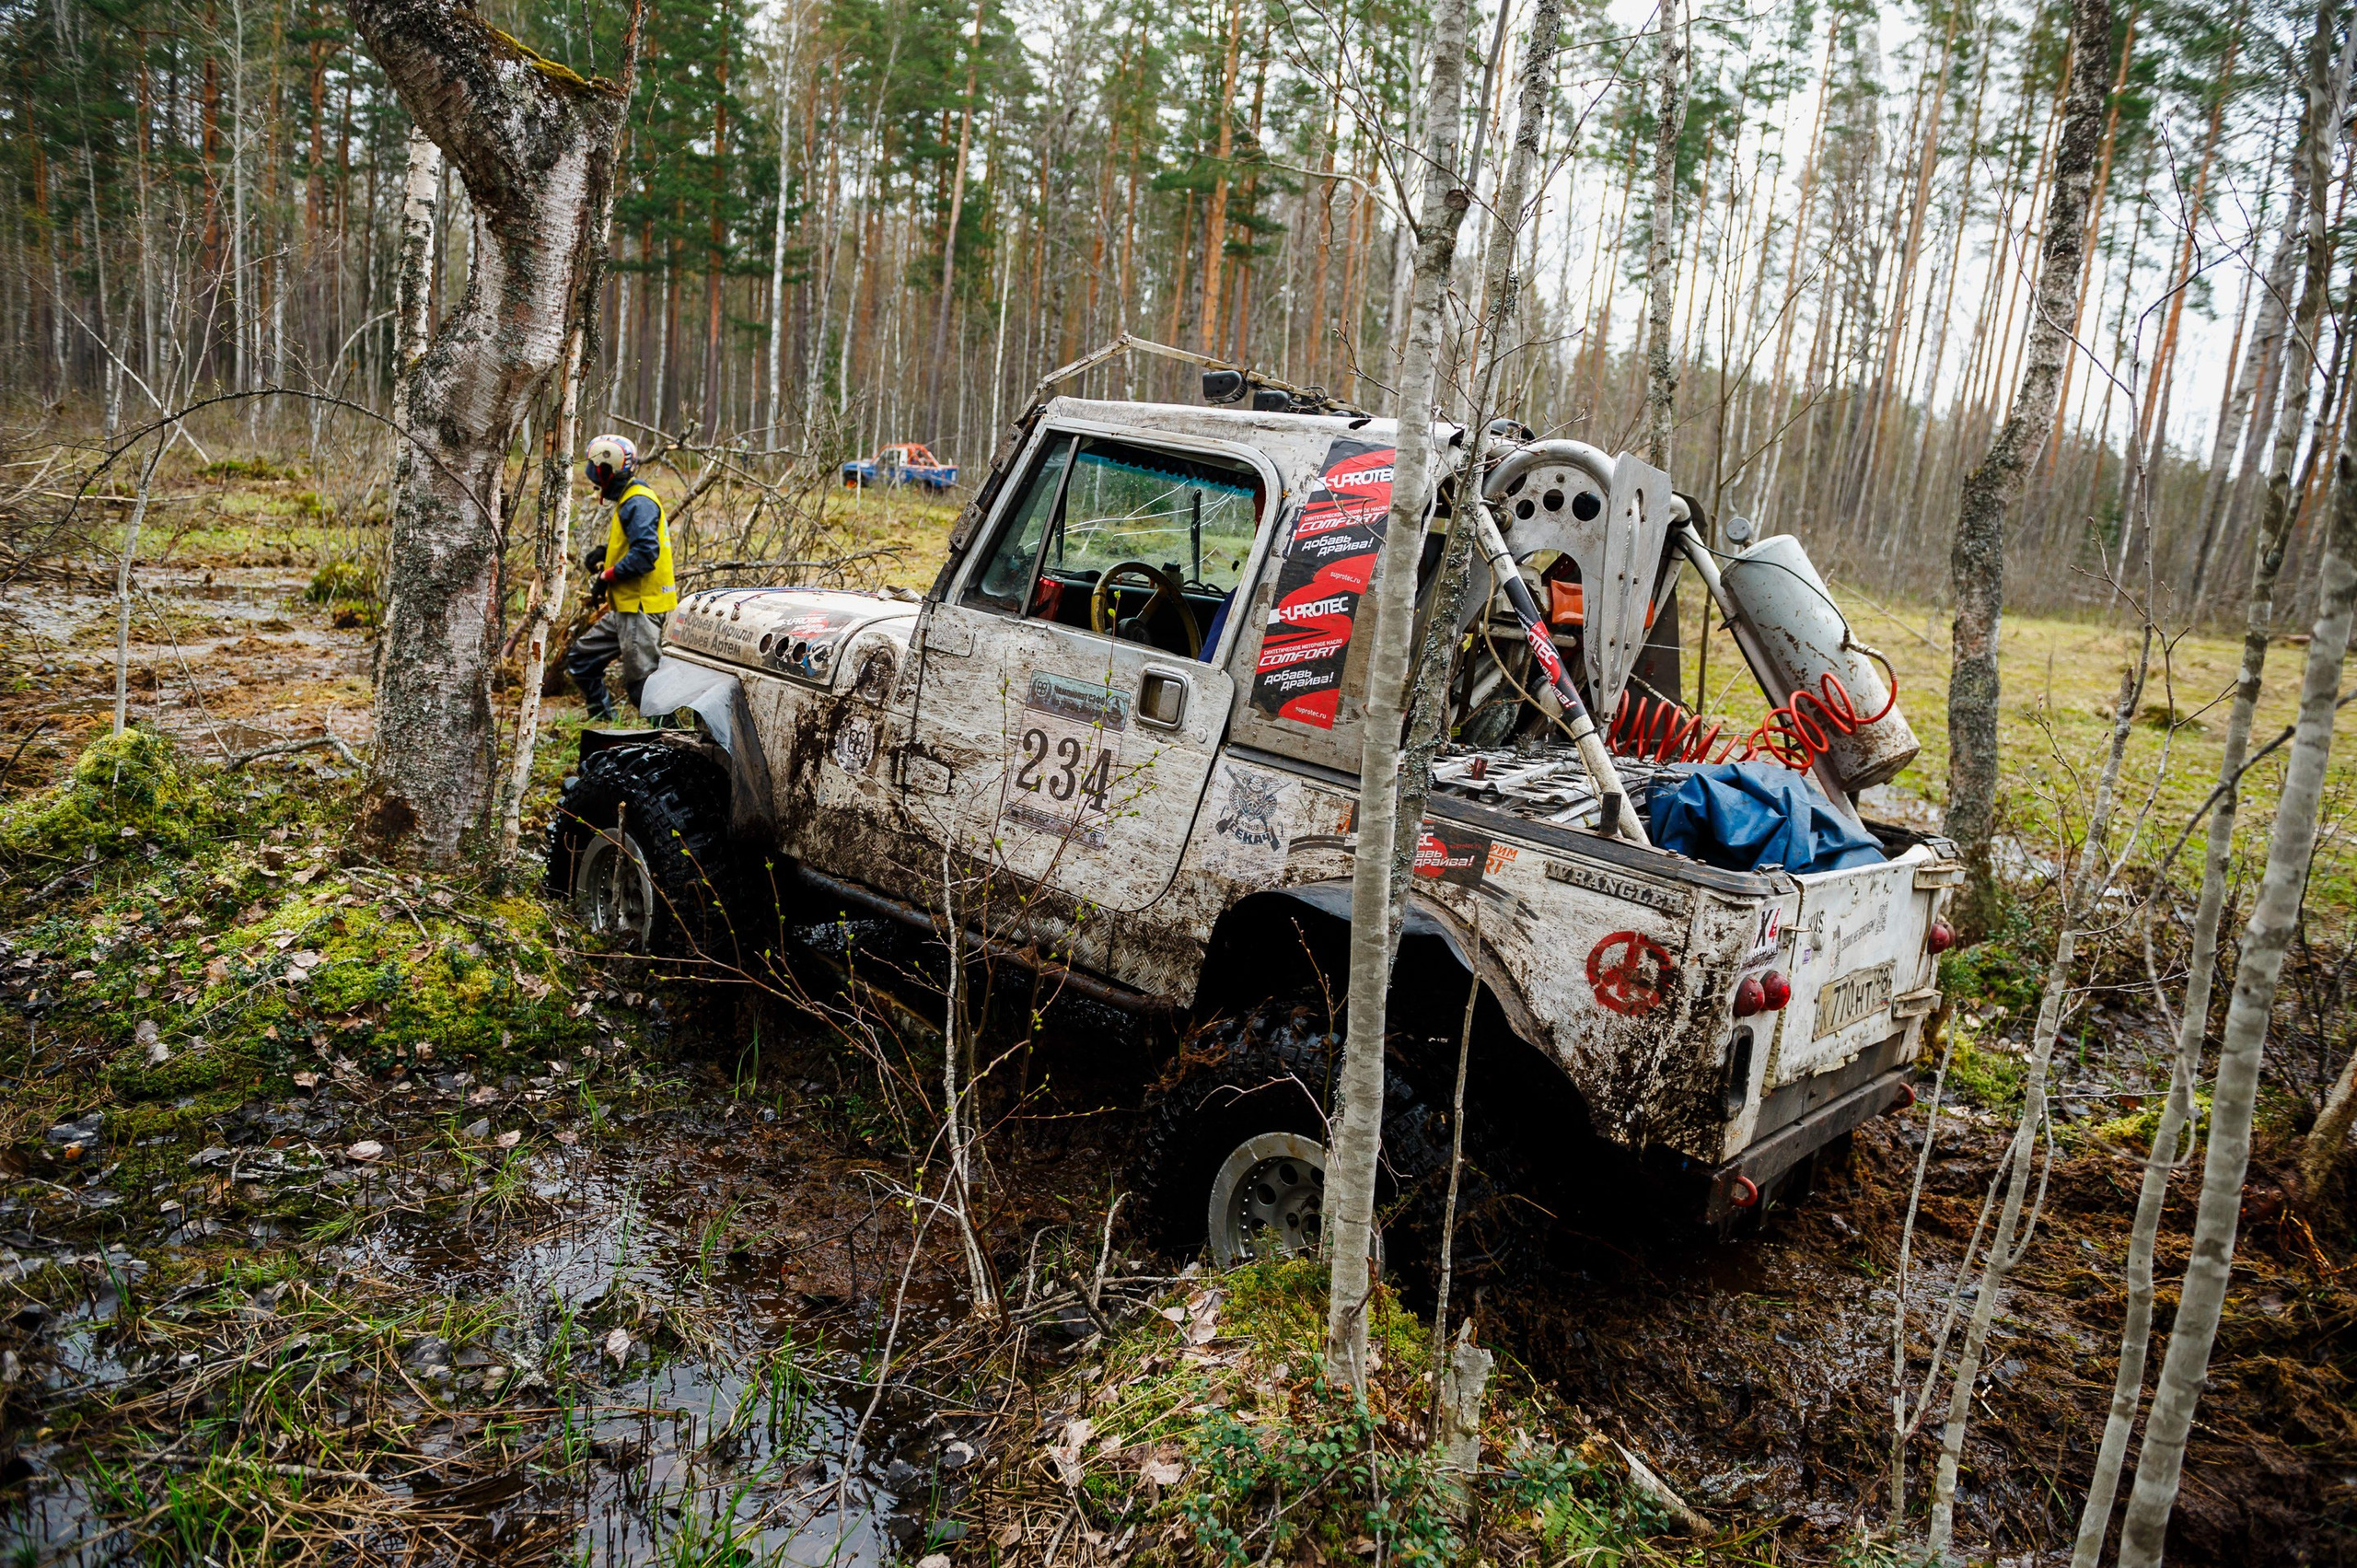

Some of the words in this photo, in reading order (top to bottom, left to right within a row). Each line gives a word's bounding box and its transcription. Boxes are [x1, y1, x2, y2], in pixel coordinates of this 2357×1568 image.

[1313, 468, 1394, 491] SUPROTE
[1298, 512, 1384, 532] COMFORT
[1301, 535, 1352, 552] добавь
[1317, 537, 1374, 557] драйва!
[1329, 572, 1361, 584] suprotec.ru
[1268, 597, 1348, 624] SUPROTEC
[679, 626, 708, 647] Юрьев
[711, 635, 741, 657] Артем
[714, 619, 754, 644] Кирилл
[1327, 638, 1342, 646] МАСЛО
[1260, 645, 1340, 667] COMFORT
[1264, 669, 1312, 685] добавь
[1280, 671, 1334, 691] драйва!
[1295, 706, 1327, 719] suprotec.ru
[1016, 728, 1112, 812] 234
[1546, 861, 1685, 914] WRANGLER
